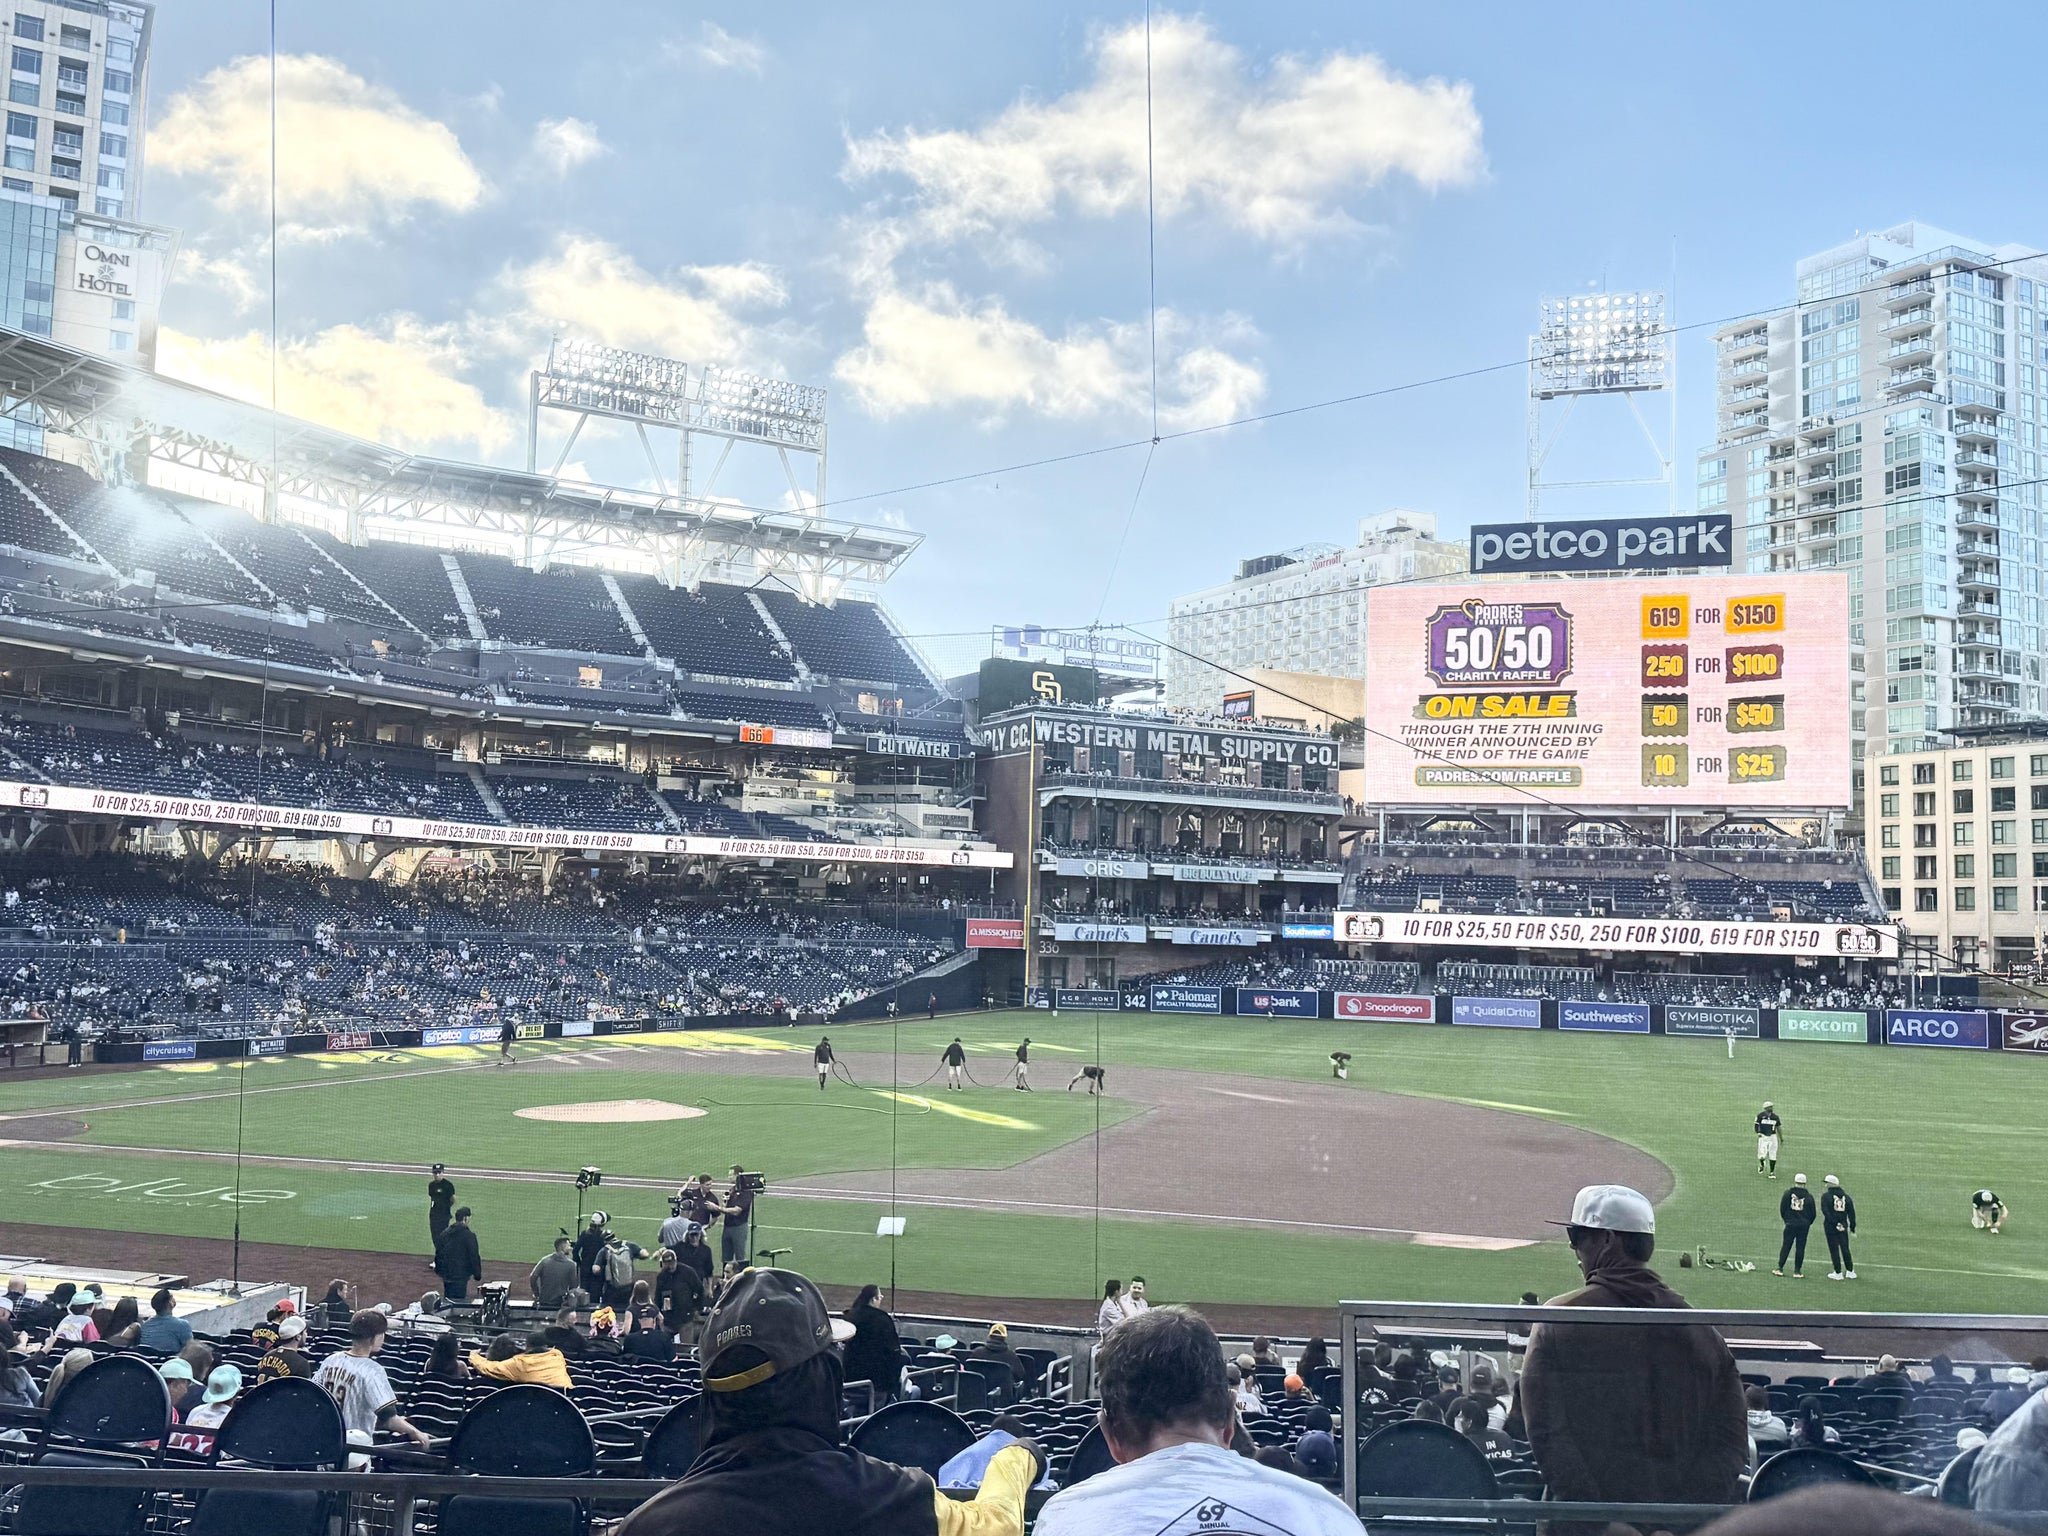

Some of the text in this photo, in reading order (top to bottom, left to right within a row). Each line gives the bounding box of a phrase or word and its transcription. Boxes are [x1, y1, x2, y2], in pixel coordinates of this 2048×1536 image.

[85, 245, 130, 267] OMNI
[78, 273, 132, 296] HOTEL
[1475, 521, 1726, 570] petco park
[1475, 605, 1523, 619] PADRES
[1650, 604, 1776, 627] 619 FOR $150
[1445, 625, 1552, 670] 50/50
[1646, 653, 1777, 677] 250 FOR $100
[1446, 671, 1551, 682] CHARITY RAFFLE
[1425, 695, 1571, 718] ON SALE
[1652, 702, 1774, 727] 50 FOR $50
[749, 728, 763, 742] 66
[1400, 724, 1604, 735] THROUGH THE 7TH INNING
[878, 738, 950, 757] CUTWATER
[1034, 720, 1336, 767] WESTERN METAL SUPPLY CO.
[1406, 736, 1598, 747] WINNER ANNOUNCED BY
[1413, 749, 1589, 760] THE END OF THE GAME
[1654, 753, 1774, 777] 10 FOR $25
[1426, 770, 1571, 783] PADRES.COM/RAFFLE
[92, 795, 104, 808] 10
[106, 796, 128, 811] FOR
[169, 801, 189, 816] FOR
[191, 803, 213, 819] $50,
[215, 805, 235, 819] 250
[236, 807, 255, 821] FOR
[255, 809, 281, 825] $100,
[284, 811, 300, 825] 619
[301, 813, 320, 827] FOR
[320, 815, 342, 828] $150
[422, 823, 432, 835] 10
[432, 824, 447, 837] FOR
[476, 828, 490, 840] FOR
[509, 831, 523, 842] 250
[524, 832, 543, 843] FOR
[544, 833, 569, 846] $100,
[572, 834, 589, 845] 619
[591, 835, 609, 847] FOR
[610, 836, 633, 848] $150
[720, 841, 729, 852] 10
[731, 842, 747, 853] FOR
[780, 844, 796, 855] FOR
[818, 846, 833, 857] 250
[835, 847, 850, 858] FOR
[875, 849, 888, 859] 619
[890, 850, 905, 860] FOR
[906, 851, 924, 861] $150
[1084, 862, 1124, 877] ORIS
[978, 928, 1024, 937] MISSION FED
[1074, 926, 1130, 942] Canel's
[1190, 929, 1242, 945] Canel's
[1403, 919, 1420, 936] 10
[1424, 920, 1451, 937] FOR
[1515, 922, 1545, 940] FOR
[1549, 923, 1585, 943] $50,
[1589, 924, 1621, 942] 250
[1625, 925, 1657, 943] FOR
[1660, 925, 1704, 946] $100,
[1710, 928, 1739, 946] 619
[1743, 929, 1775, 946] FOR
[1779, 929, 1819, 948] $150
[1039, 941, 1060, 954] 336
[1124, 994, 1146, 1008] 342
[1171, 990, 1217, 1002] Palomar
[1271, 996, 1300, 1008] bank
[1365, 1002, 1423, 1014] Snapdragon
[1473, 1007, 1536, 1018] QuidelOrtho
[1564, 1009, 1635, 1024] Southwest
[1669, 1011, 1755, 1024] CYMBIOTIKA
[436, 1030, 462, 1042] petco
[1890, 1018, 1959, 1039] ARCO
[146, 1046, 187, 1056] citycruises
[717, 1325, 752, 1347] PADRES
